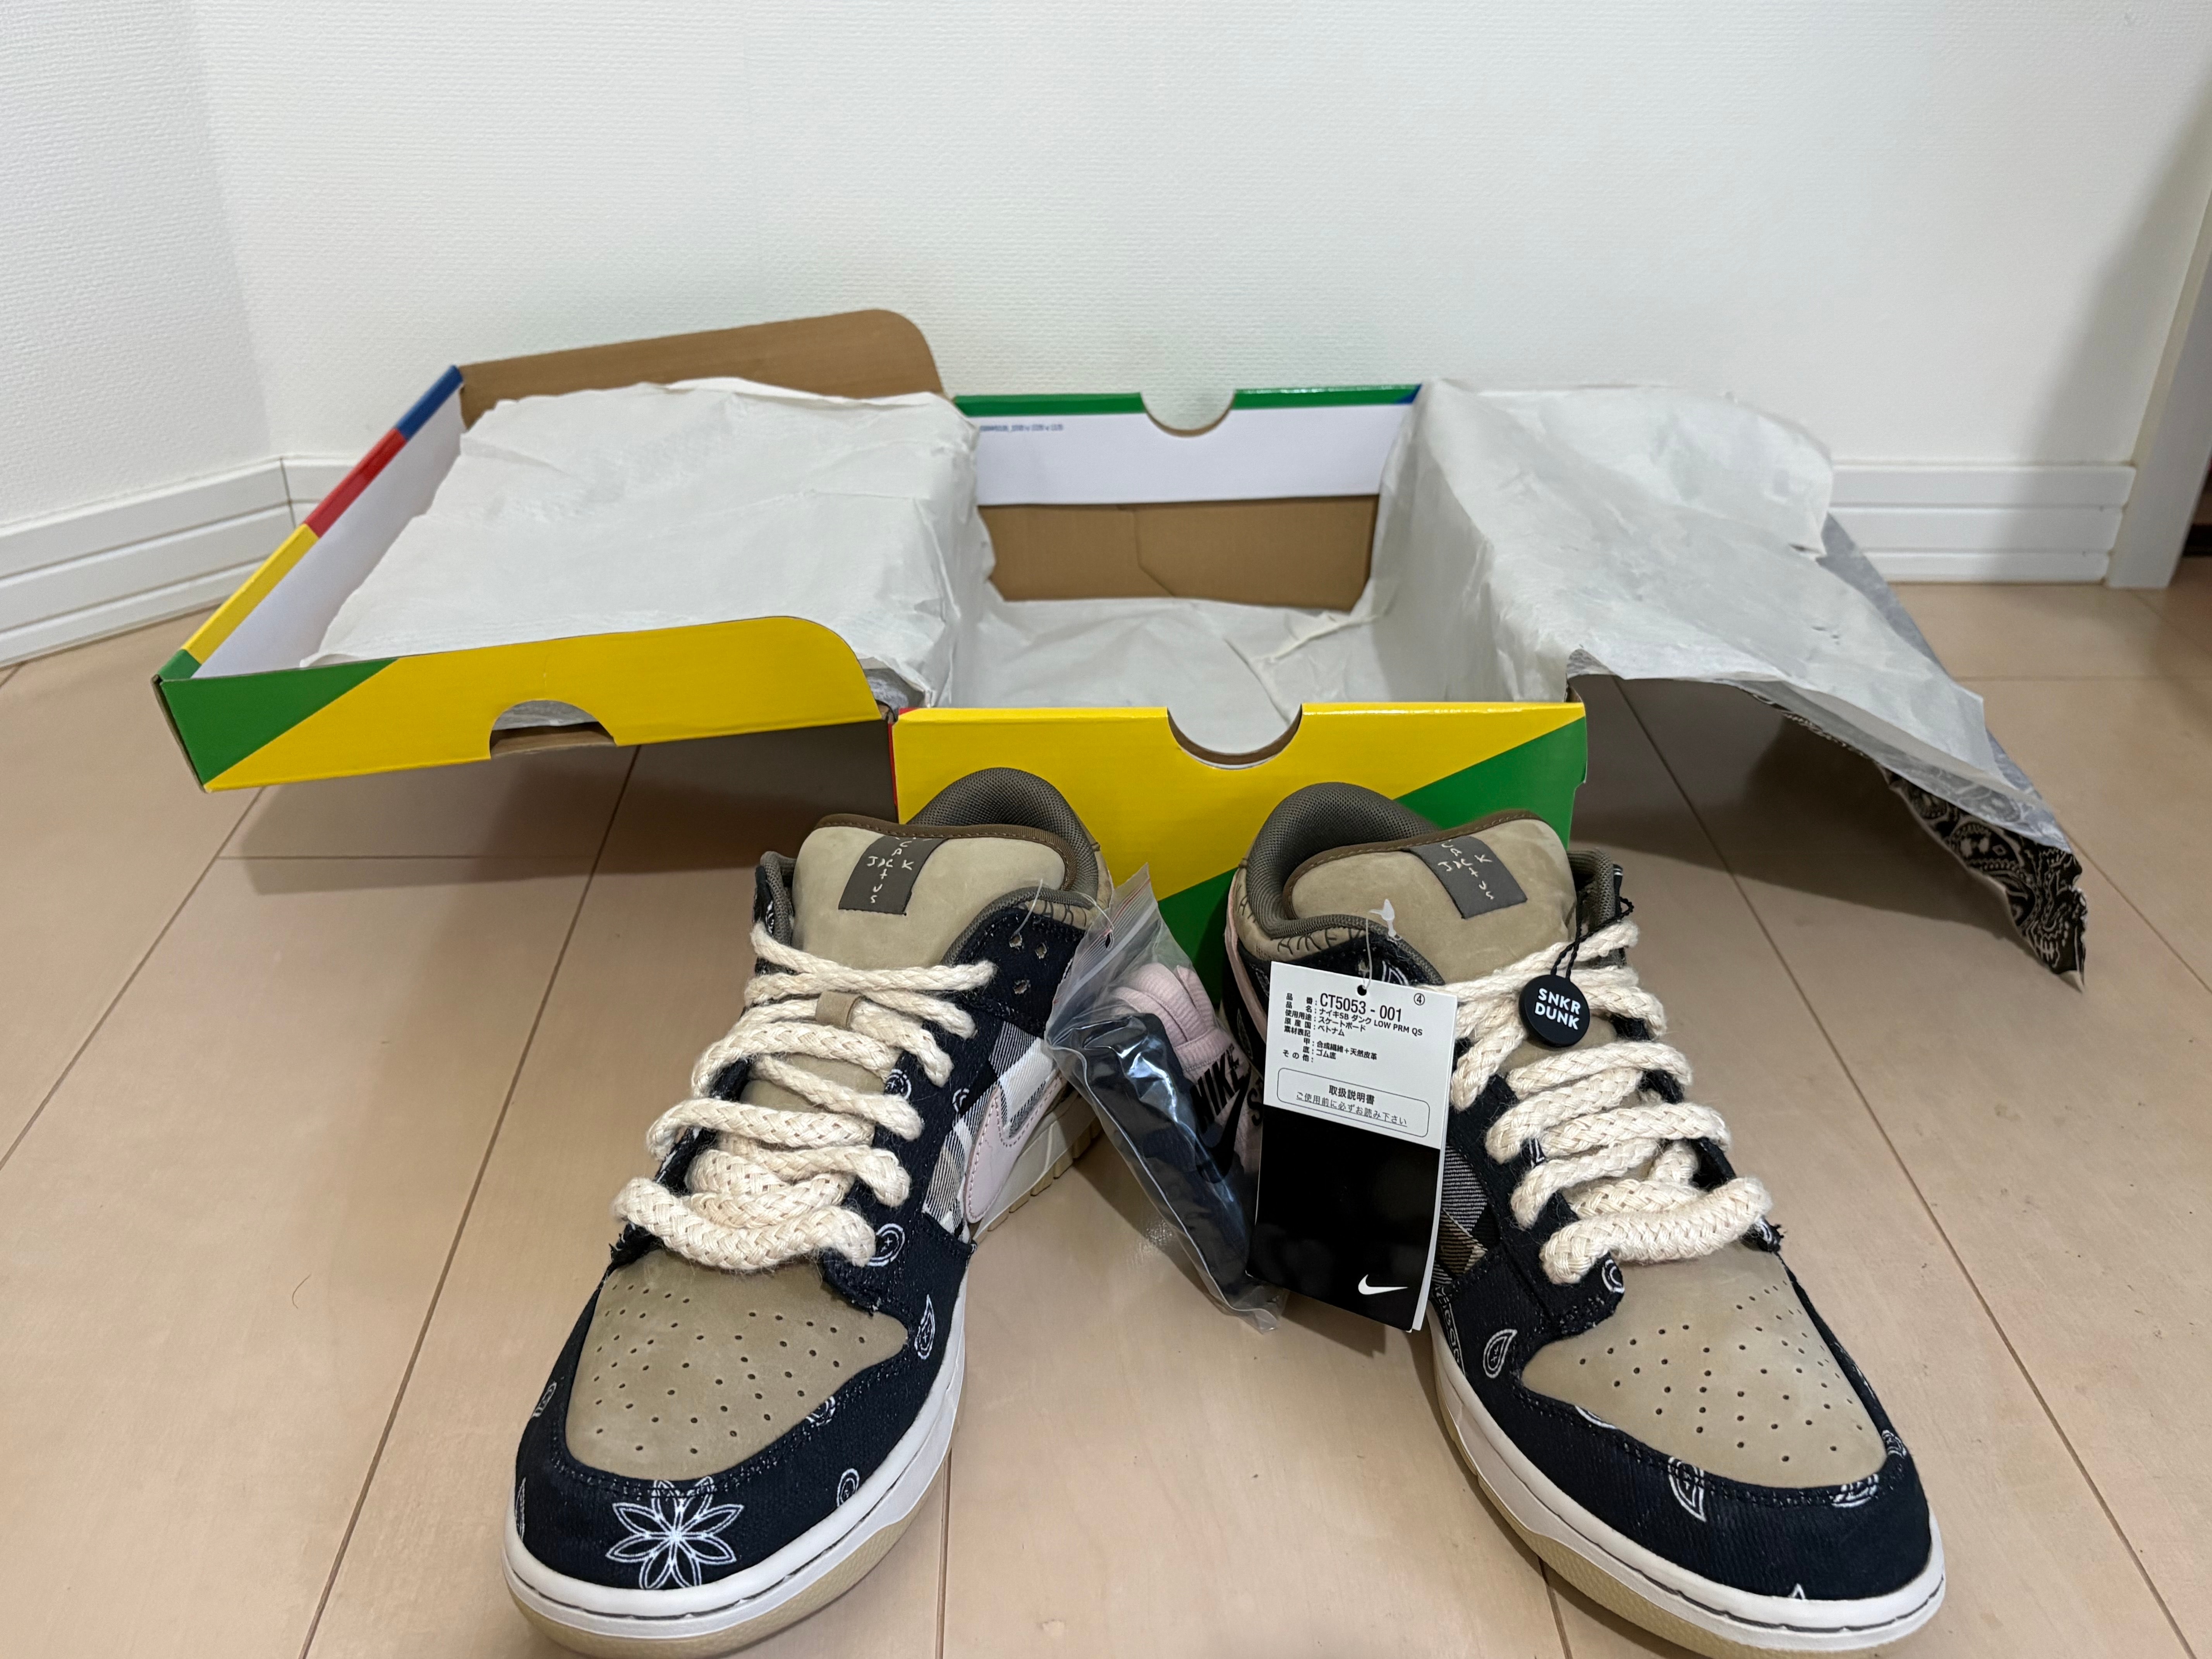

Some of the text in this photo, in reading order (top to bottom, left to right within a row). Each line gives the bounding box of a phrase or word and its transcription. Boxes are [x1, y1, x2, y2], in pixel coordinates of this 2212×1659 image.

[1538, 988, 1581, 1015] SNKR
[1374, 1019, 1391, 1029] LOW
[1393, 1024, 1410, 1033] PRM
[1412, 1027, 1423, 1037] QS
[1534, 1001, 1580, 1030] DUNK
[1296, 1092, 1407, 1125] ご使用前に必ずお読み下さい
[1329, 1085, 1375, 1105] 取扱説明書
